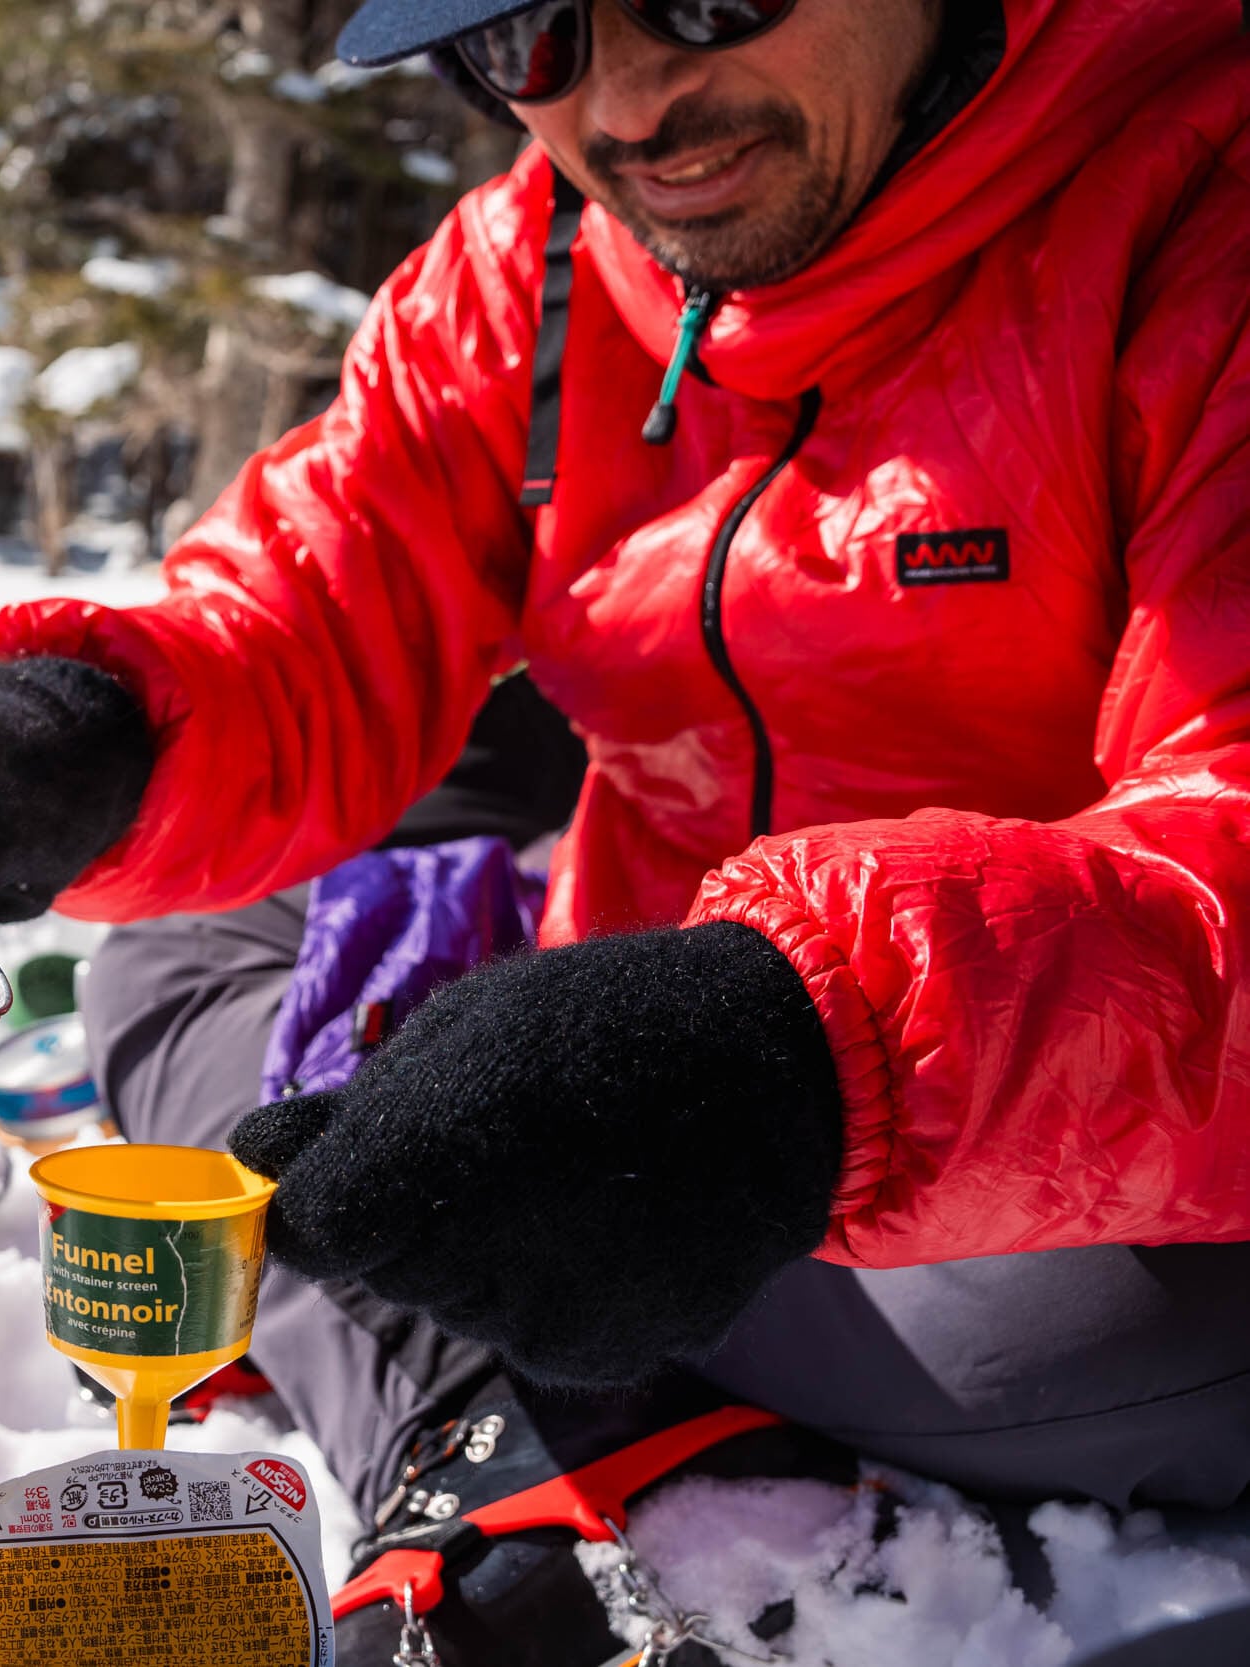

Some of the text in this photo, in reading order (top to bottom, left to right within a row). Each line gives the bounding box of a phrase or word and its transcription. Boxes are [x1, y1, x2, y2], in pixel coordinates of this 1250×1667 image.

[52, 1232, 154, 1274] Funnel
[71, 1271, 114, 1289] strainer
[116, 1281, 158, 1292] screen
[45, 1272, 179, 1324] Entonnoir
[68, 1317, 136, 1339] avec crépine
[143, 1472, 172, 1483] CHECK!
[255, 1461, 304, 1504] NISSIN
[24, 1486, 48, 1499] 3分
[100, 1488, 120, 1502] プラ
[145, 1484, 173, 1494] ここから
[66, 1490, 82, 1505] 紙
[21, 1512, 53, 1523] 300ml
